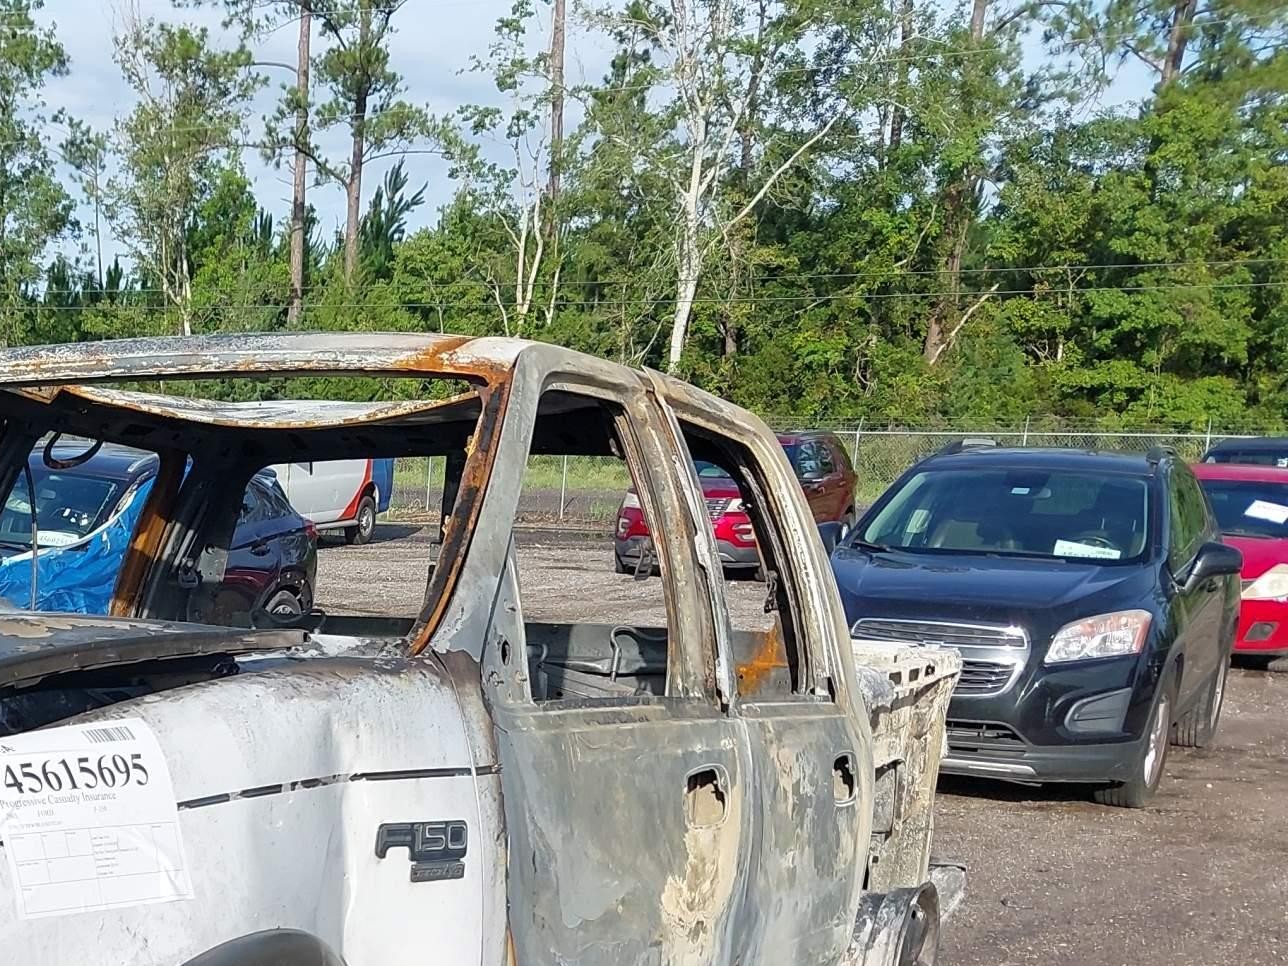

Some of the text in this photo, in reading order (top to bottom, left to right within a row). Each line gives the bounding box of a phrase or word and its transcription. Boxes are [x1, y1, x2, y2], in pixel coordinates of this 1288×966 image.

[4, 753, 149, 794] 45615695
[0, 791, 117, 810] Progressive Casualty Insurance
